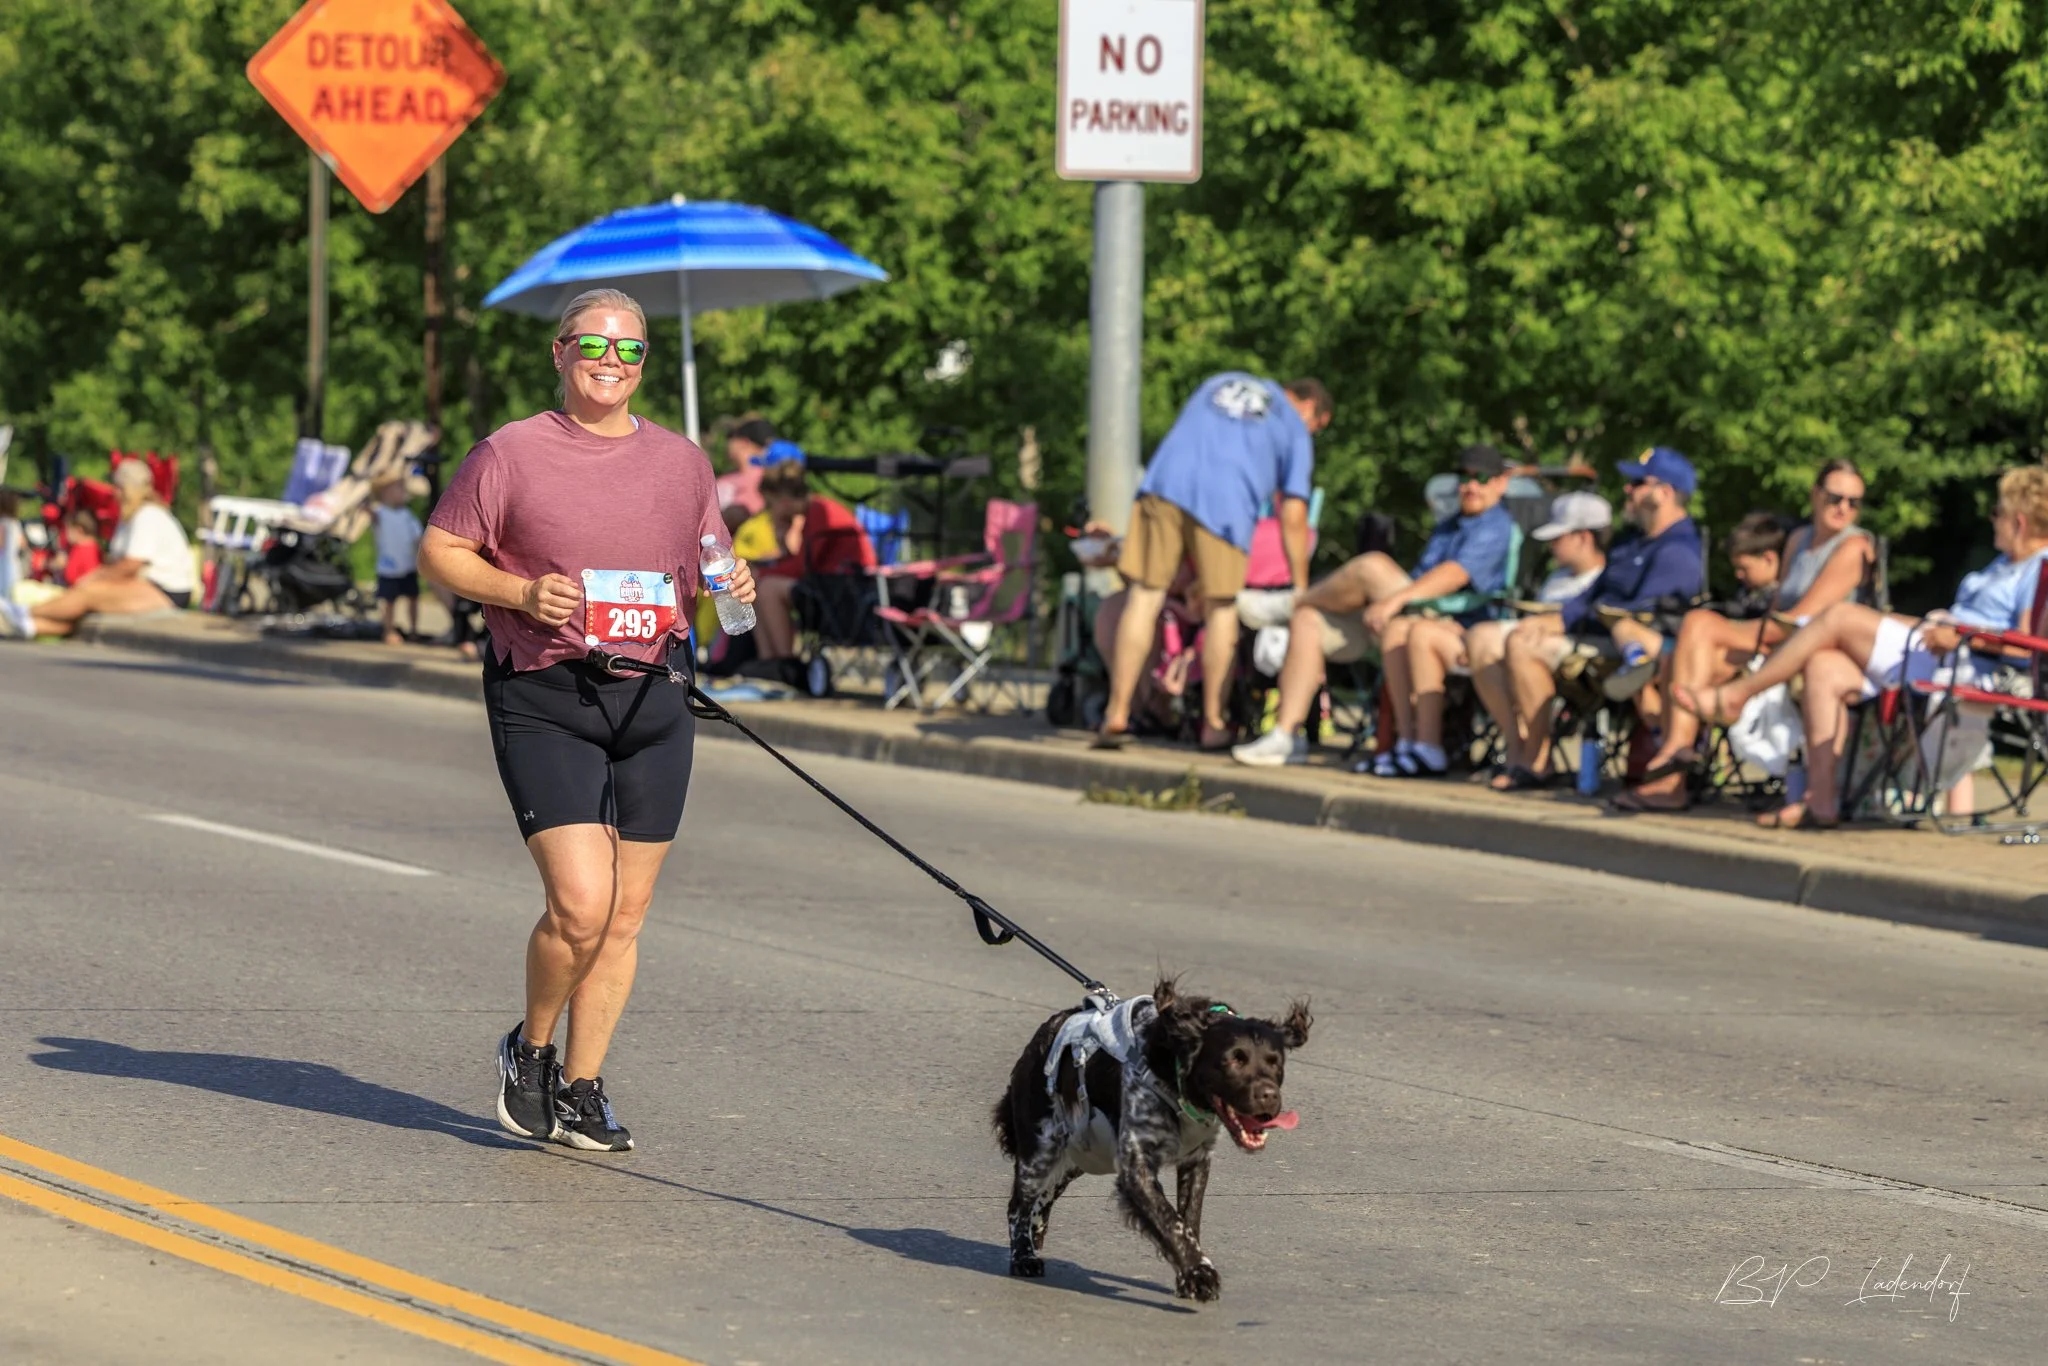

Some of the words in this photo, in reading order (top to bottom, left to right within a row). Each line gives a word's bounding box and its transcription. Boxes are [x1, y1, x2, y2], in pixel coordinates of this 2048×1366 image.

[307, 32, 451, 72] DETOUR
[1100, 34, 1163, 75] NO
[311, 84, 449, 126] AHEAD
[1070, 98, 1189, 136] PARKING
[608, 607, 657, 639] 293
